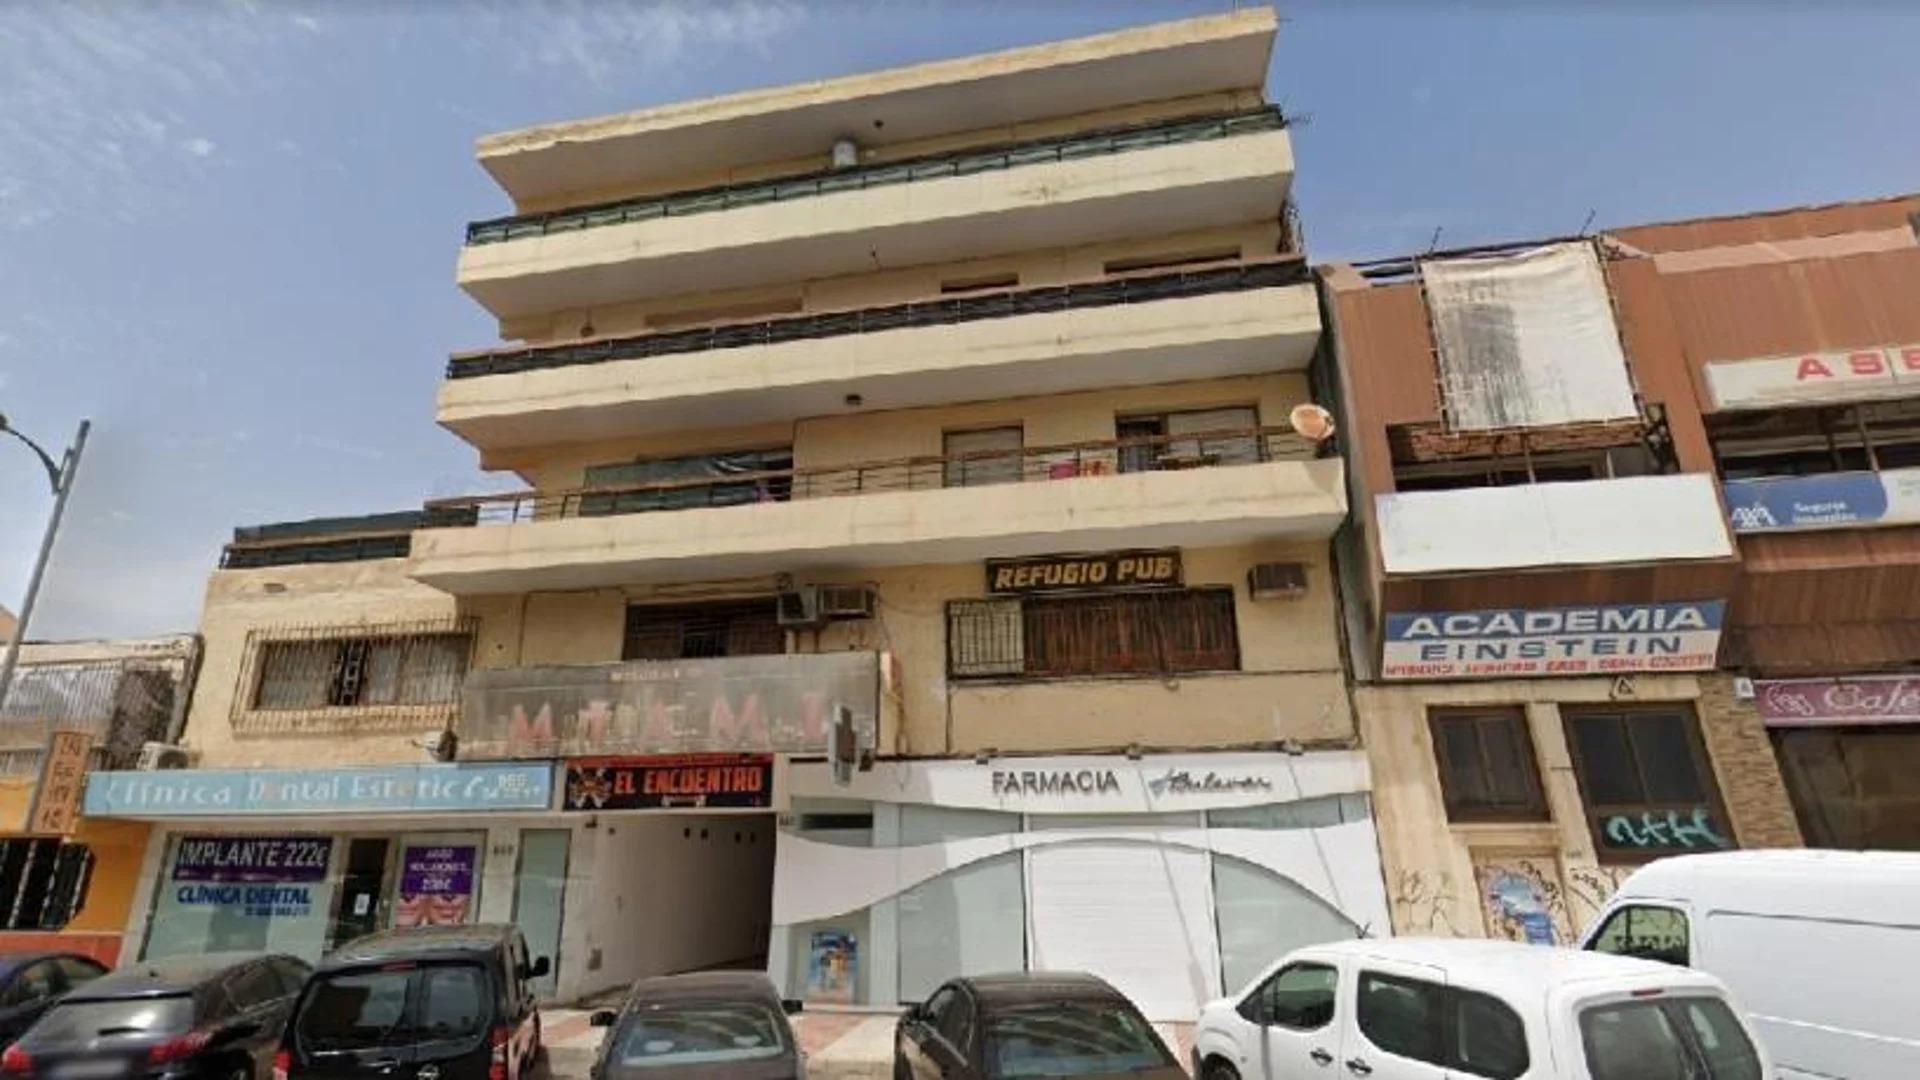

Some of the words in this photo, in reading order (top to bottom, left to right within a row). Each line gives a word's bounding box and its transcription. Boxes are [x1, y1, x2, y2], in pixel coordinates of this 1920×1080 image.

[1732, 504, 1776, 528] AXA
[995, 562, 1107, 589] REFUGIO
[1117, 556, 1174, 581] PUB
[1402, 607, 1707, 639] ACADEMIA
[1421, 636, 1682, 661] EINSTEIN
[614, 771, 636, 794] EL
[643, 766, 763, 794] ENCUENTRO
[991, 770, 1120, 794] FARMACIA
[178, 839, 280, 867] IMPLANTE
[245, 886, 311, 904] DENTAL
